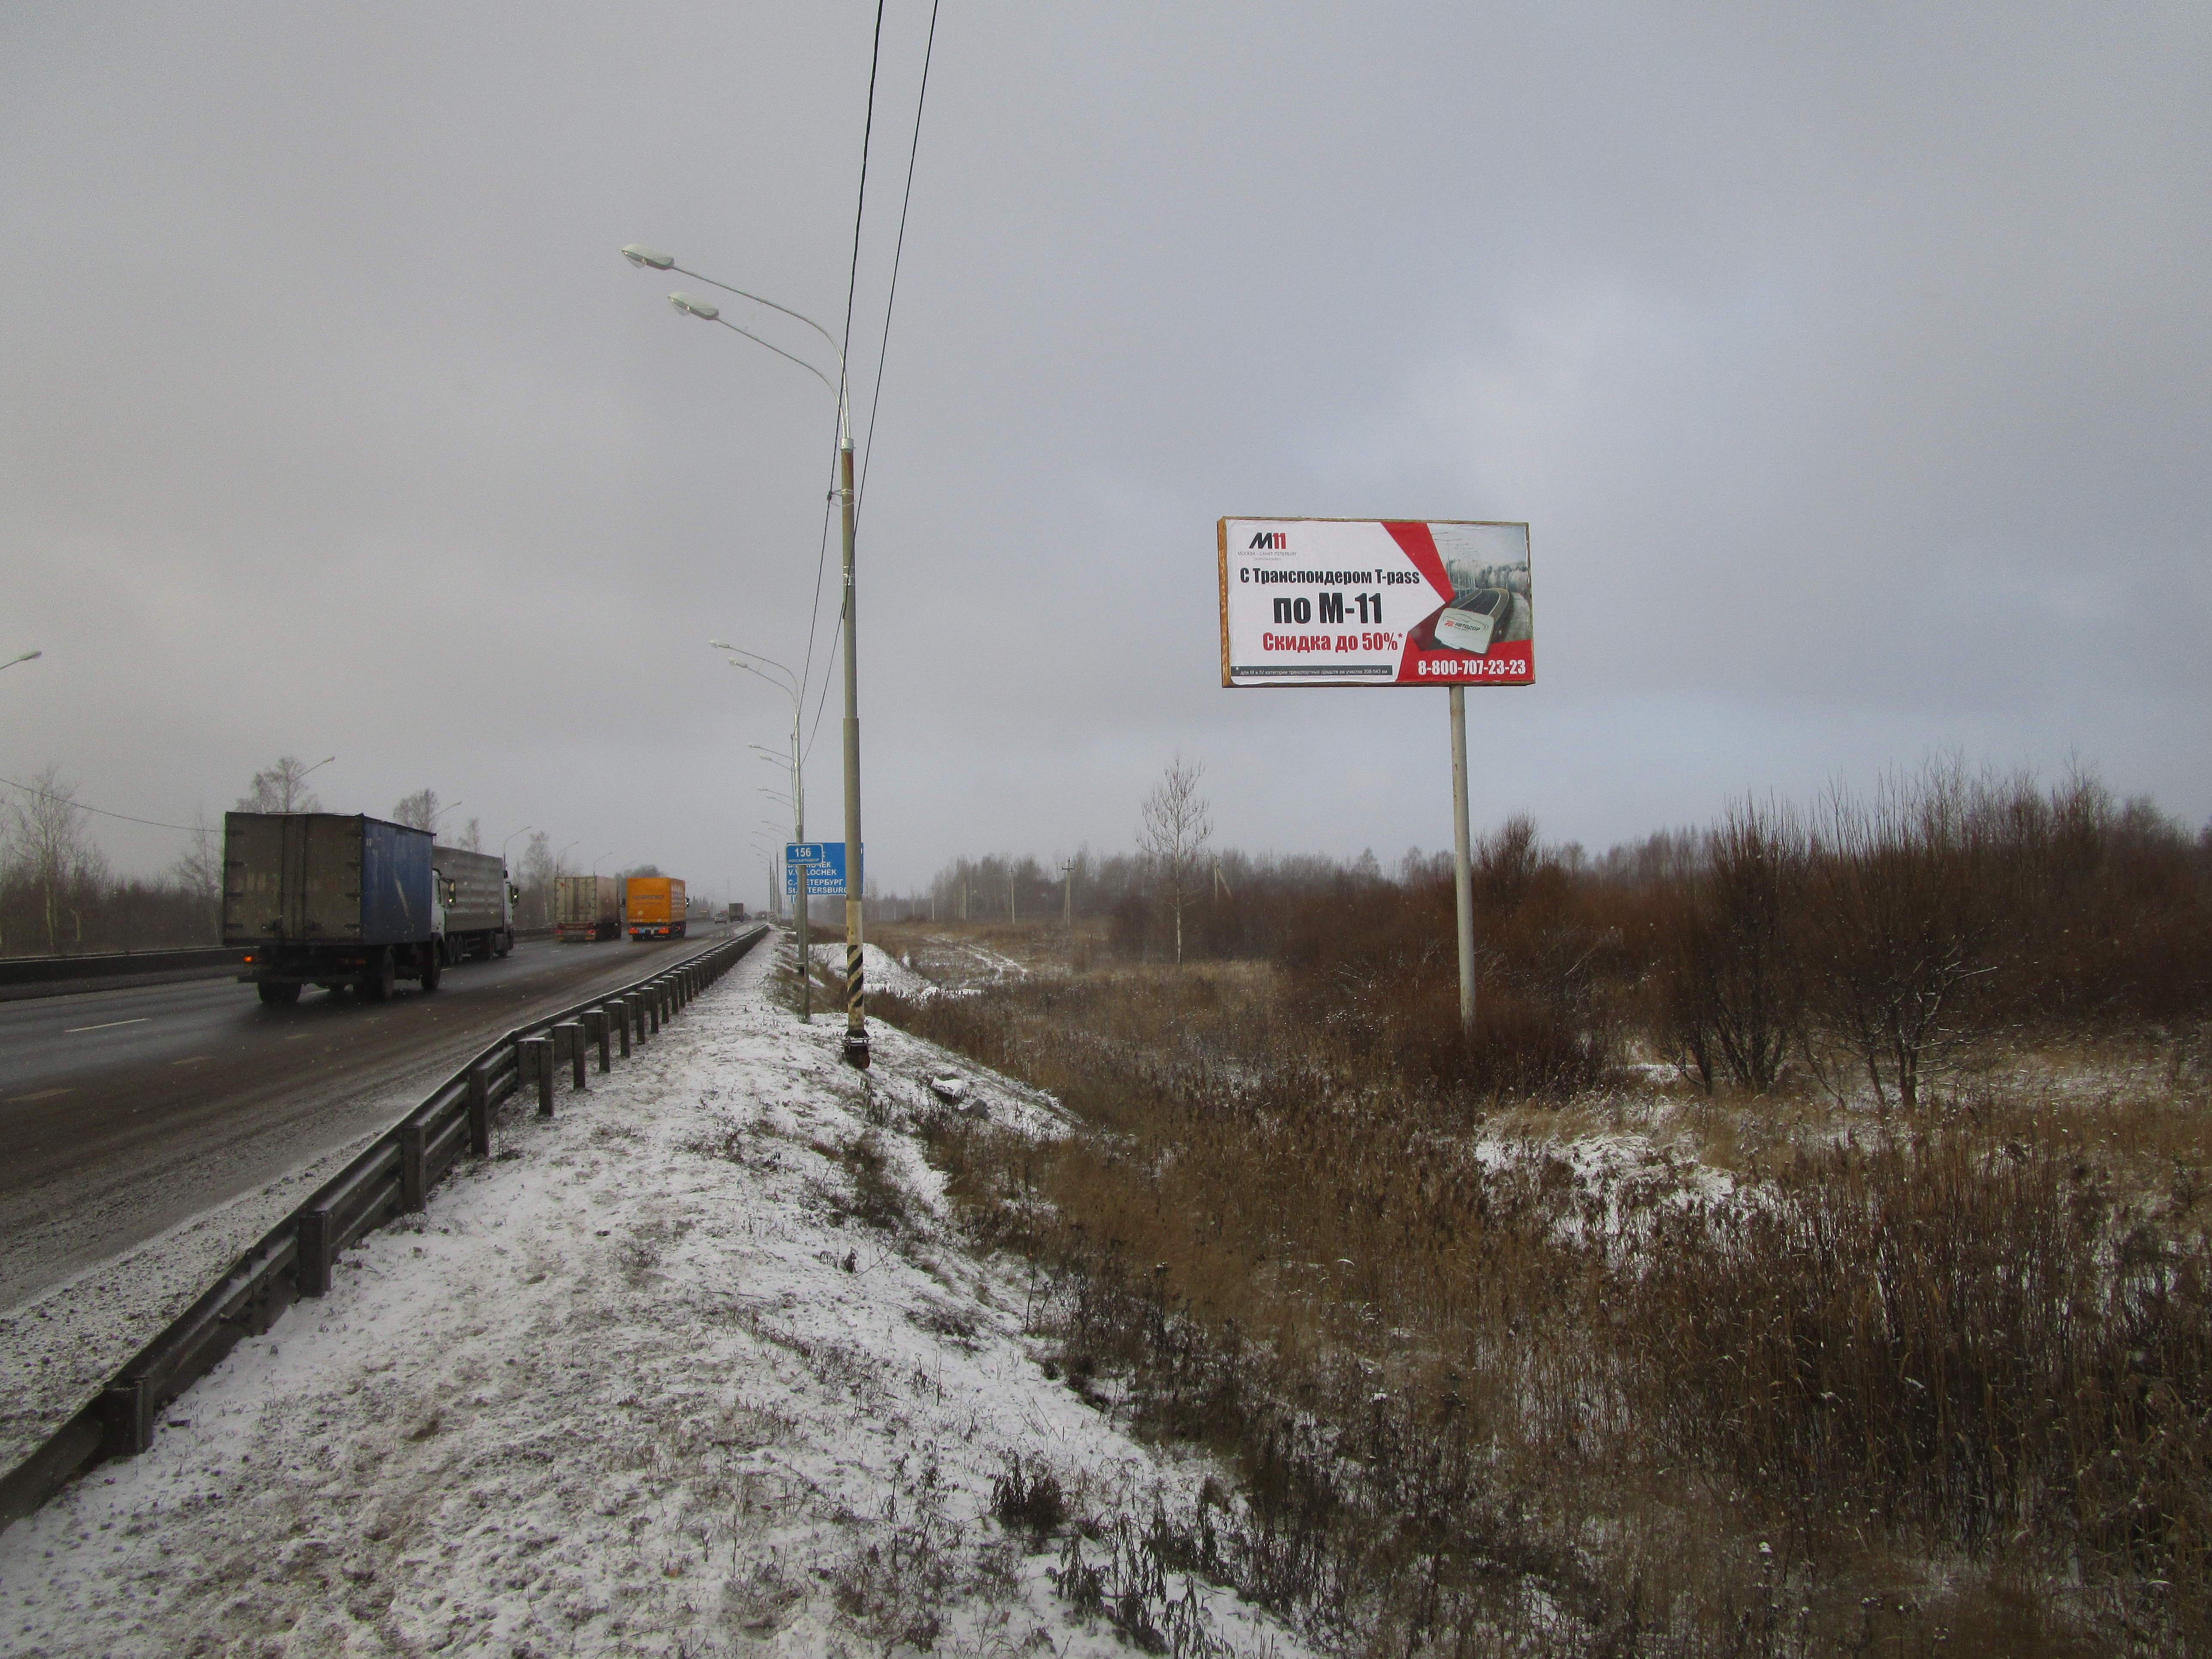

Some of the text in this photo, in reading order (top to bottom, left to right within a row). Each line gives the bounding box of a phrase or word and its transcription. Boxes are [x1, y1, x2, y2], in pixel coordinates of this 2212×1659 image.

[1248, 532, 1286, 549] М11
[1240, 567, 1420, 585] С Транспондером T-pass
[1273, 592, 1382, 624] по М-11
[1455, 622, 1481, 631] АВТОДОР
[1263, 632, 1331, 653] Скидка
[1335, 635, 1358, 653] до
[1418, 659, 1526, 675] 8-800-707-23-23
[794, 847, 811, 857] 156
